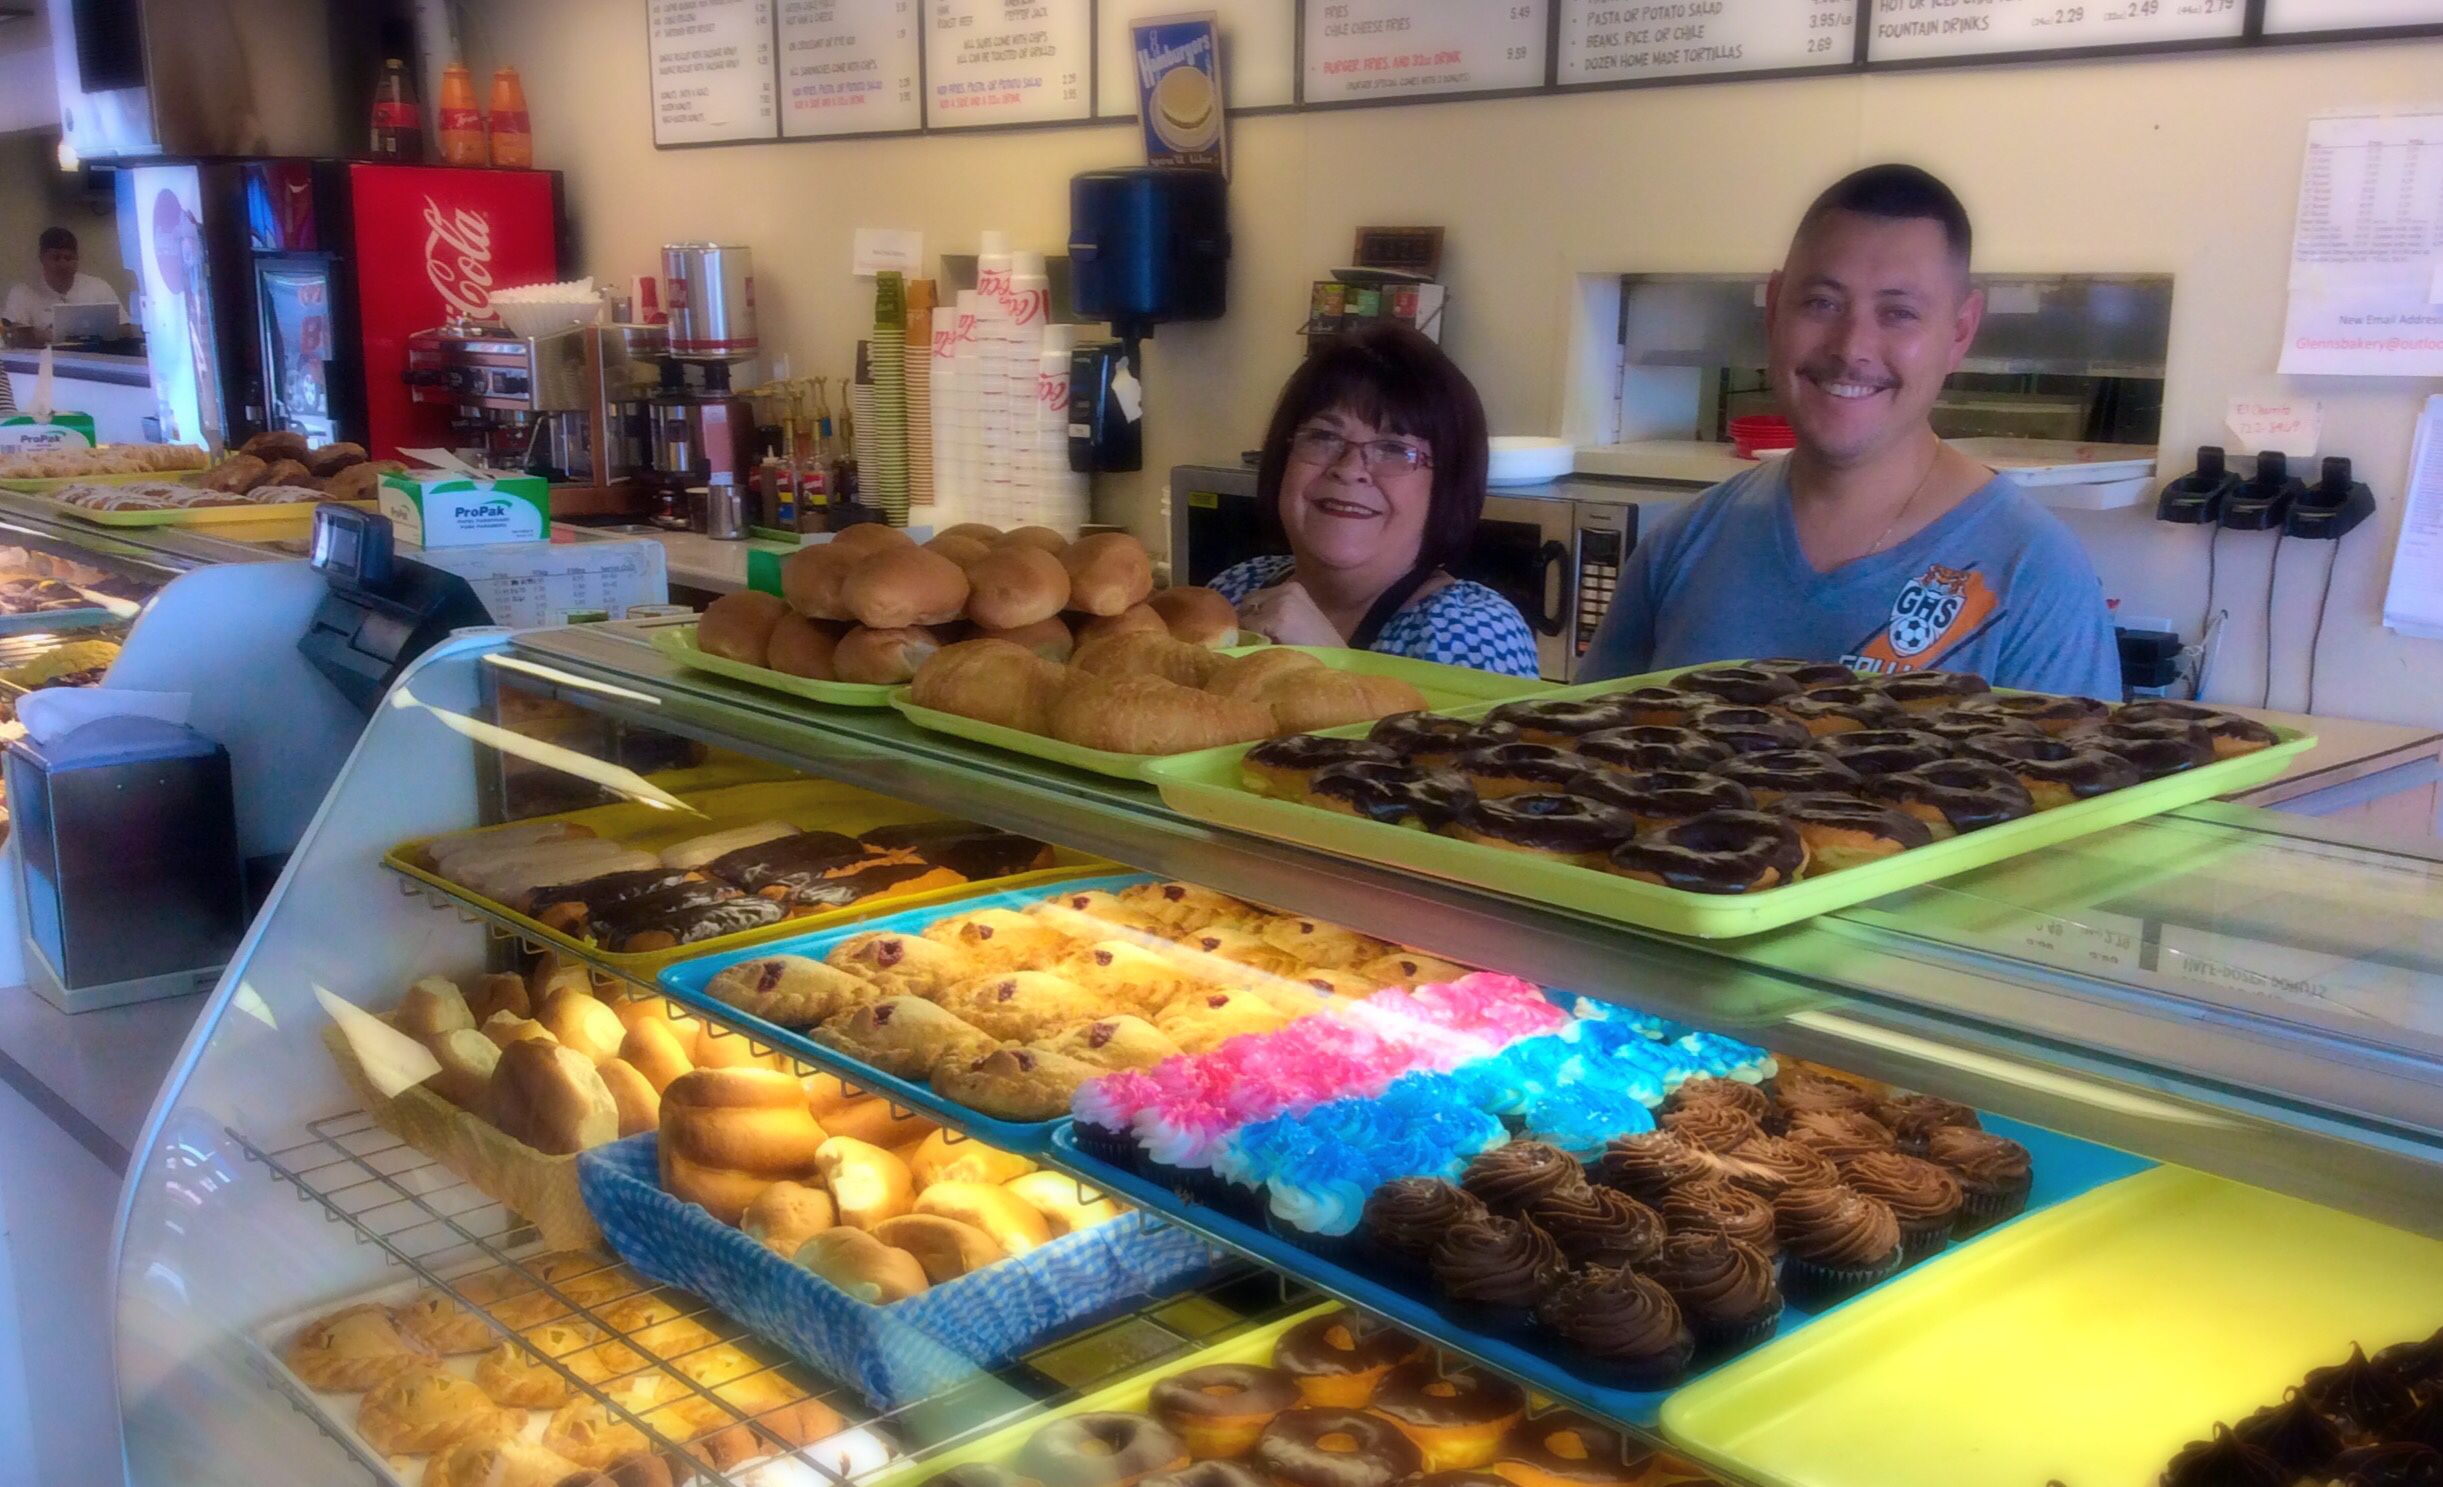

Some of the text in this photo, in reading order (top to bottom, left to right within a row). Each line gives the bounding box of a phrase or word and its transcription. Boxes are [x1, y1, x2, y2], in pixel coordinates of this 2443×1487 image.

[1587, 1, 1723, 26] PASTA OR POTATO SALAD
[2055, 7, 2084, 24] 2.29
[2128, 2, 2160, 18] 2.49
[1655, 27, 1671, 42] OR
[1673, 24, 1705, 41] CHILE
[1878, 15, 1990, 38] FOUNTAIN DRINKS
[1807, 37, 1832, 53] 2.69
[1584, 44, 1743, 71] DOZEN HOME MADE TORTILLAS
[424, 194, 493, 319] Cola
[2339, 315, 2362, 325] New
[2366, 314, 2396, 325] Email
[20, 434, 60, 443] ProPak
[455, 506, 505, 518] ProPak
[1897, 586, 1957, 628] GHS
